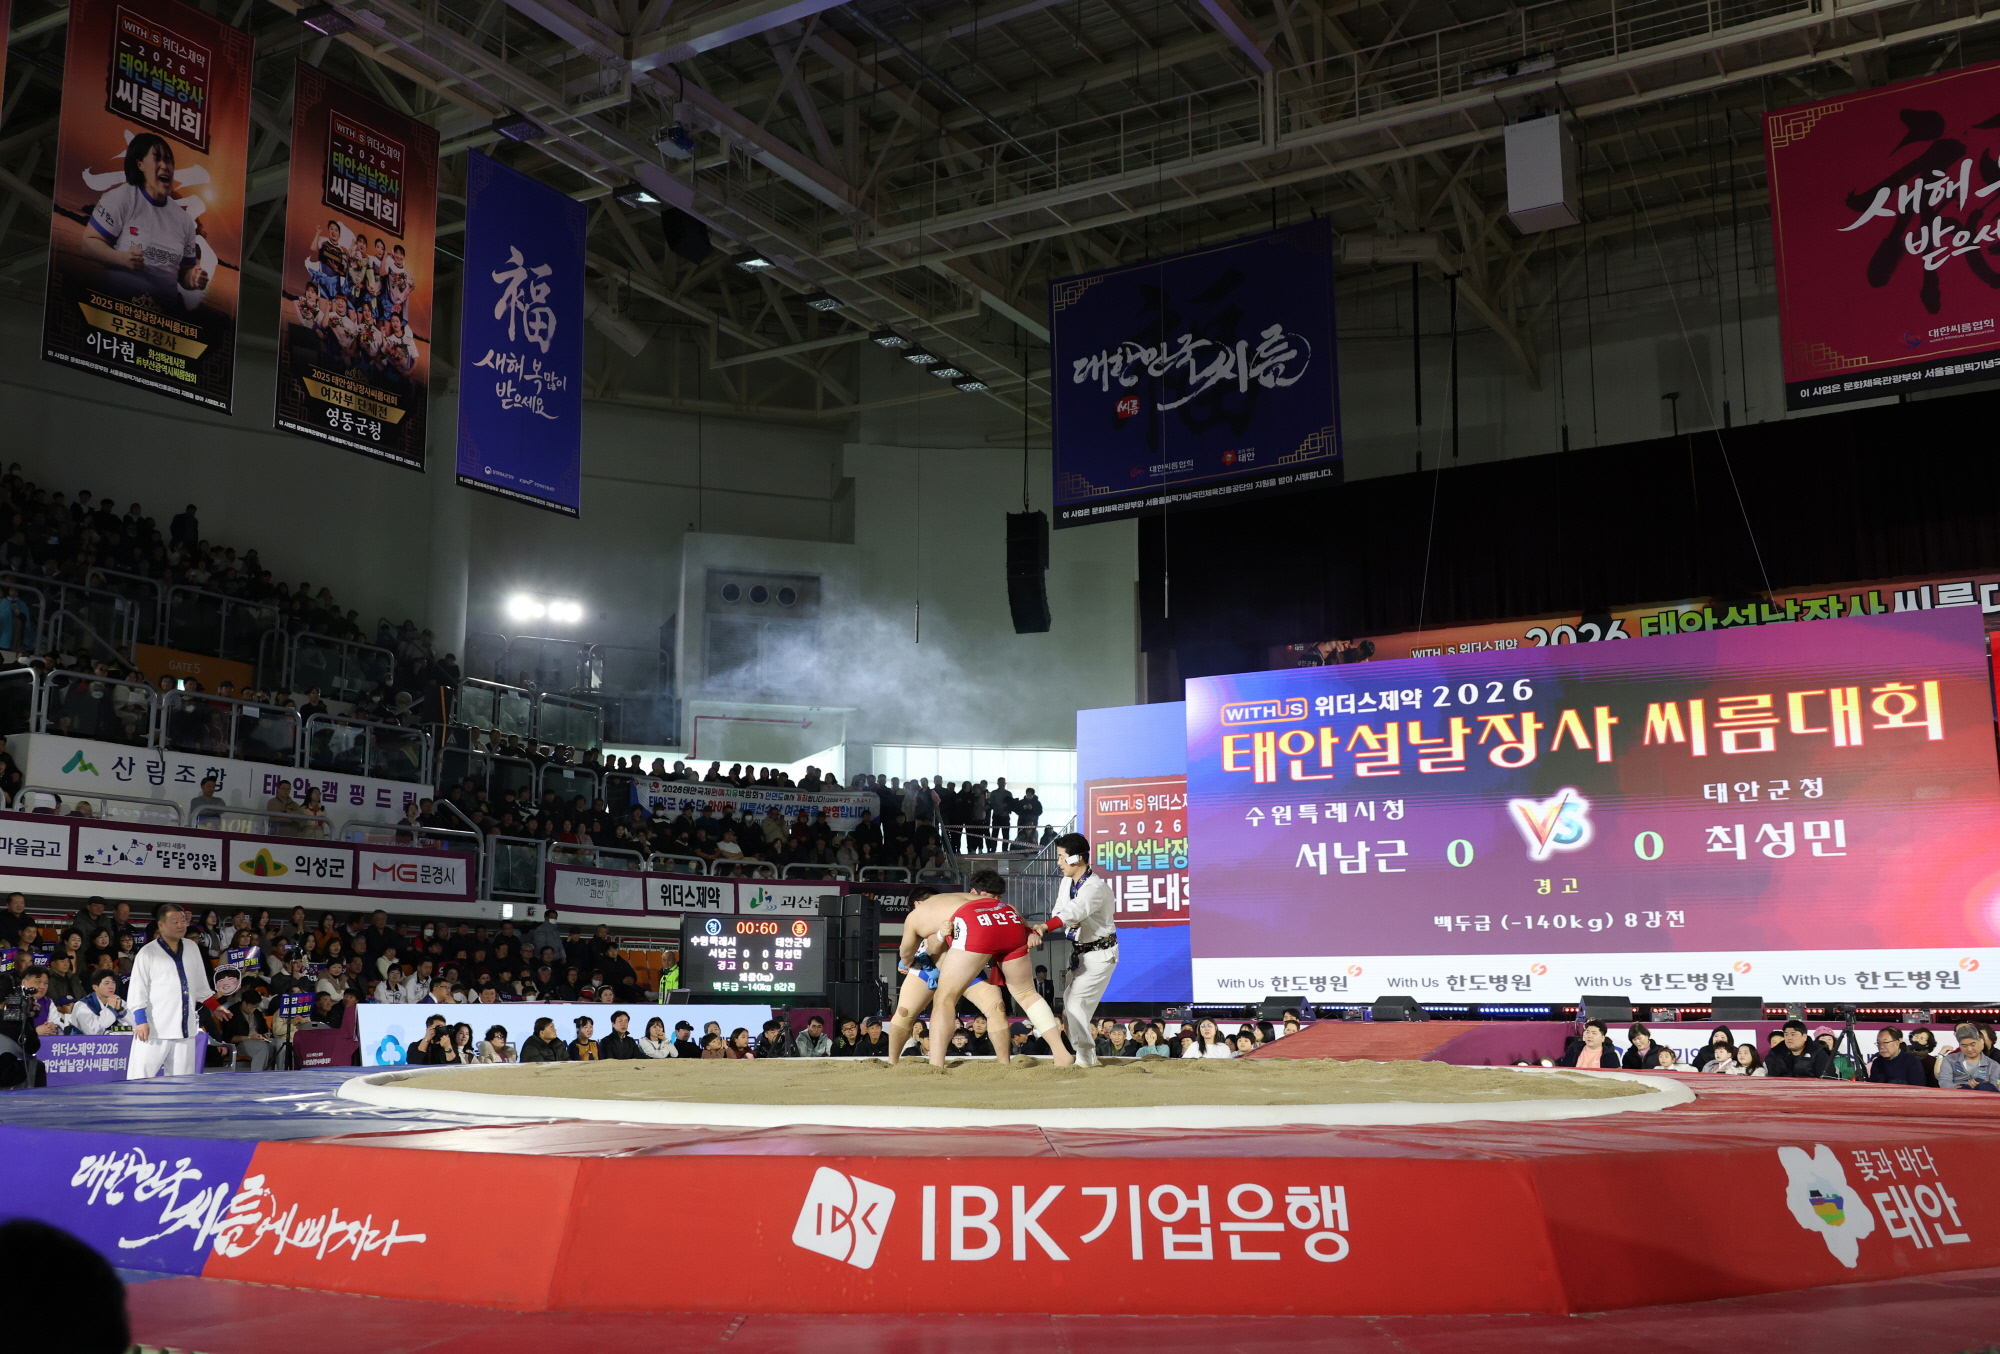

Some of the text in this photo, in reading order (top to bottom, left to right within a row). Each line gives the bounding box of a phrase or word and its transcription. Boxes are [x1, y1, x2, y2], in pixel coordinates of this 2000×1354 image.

[162, 36, 206, 68] 위더스제약
[116, 79, 201, 140] 씨름대회
[366, 136, 401, 162] 위더스제약
[330, 176, 398, 228] 씨름대회
[1836, 158, 1973, 232] 새해
[90, 294, 113, 309] 2025
[492, 245, 557, 354] 福
[111, 317, 177, 351] 무궁화장사
[1928, 318, 1994, 338] 대한씨름협회
[87, 332, 136, 364] 이다현
[312, 369, 331, 383] 2025
[472, 349, 524, 382] 새해
[1073, 324, 1311, 411] 대한민국 씨름
[1800, 388, 1809, 397] 이
[1812, 384, 1841, 396] 사업은
[1844, 370, 1922, 392] 문화체육관광부와
[321, 386, 388, 420] 여자부 단체전
[496, 379, 559, 420] 받으세요
[1117, 400, 1139, 415] 씨름
[326, 408, 382, 441] 영동군청
[1149, 459, 1194, 473] 대한씨름협회
[1238, 452, 1255, 463] 태안
[168, 660, 201, 674] GATE 5
[1315, 688, 1423, 716] 위더스제약
[1432, 679, 1534, 708] 2026
[1222, 680, 1945, 784] 태안설날장사 씨름대회
[111, 756, 227, 792] 산림조합
[1703, 777, 1824, 804] 태안군청
[1245, 799, 1405, 827] 수원특례시청
[1295, 792, 1847, 875] 서남근 0 VS 0 최성민
[157, 850, 217, 872] 달달영월
[295, 855, 345, 878] 의성군
[372, 862, 455, 885] MG 문경시
[661, 884, 721, 909] 위더스제약
[736, 922, 778, 935] 00:60
[1434, 910, 1686, 933] 백두급 (-140kg) 8강전
[708, 949, 737, 959] 서남근
[743, 950, 750, 959] 0
[762, 950, 769, 959] 0
[775, 937, 811, 948] 태안군청
[717, 961, 794, 971] 경고 0 0 경고
[1217, 975, 1348, 993] With Us 한도병원
[1387, 974, 1532, 992] With Us 한도병원
[1574, 972, 1735, 991] With Us 한도병원
[1782, 970, 1961, 990] With Us 한도병원
[51, 1043, 119, 1057] 위더스제약 2026
[1851, 1145, 1939, 1182] 꽃과 바다
[71, 1147, 202, 1224] 대한민국
[1872, 1182, 1971, 1249] 태안
